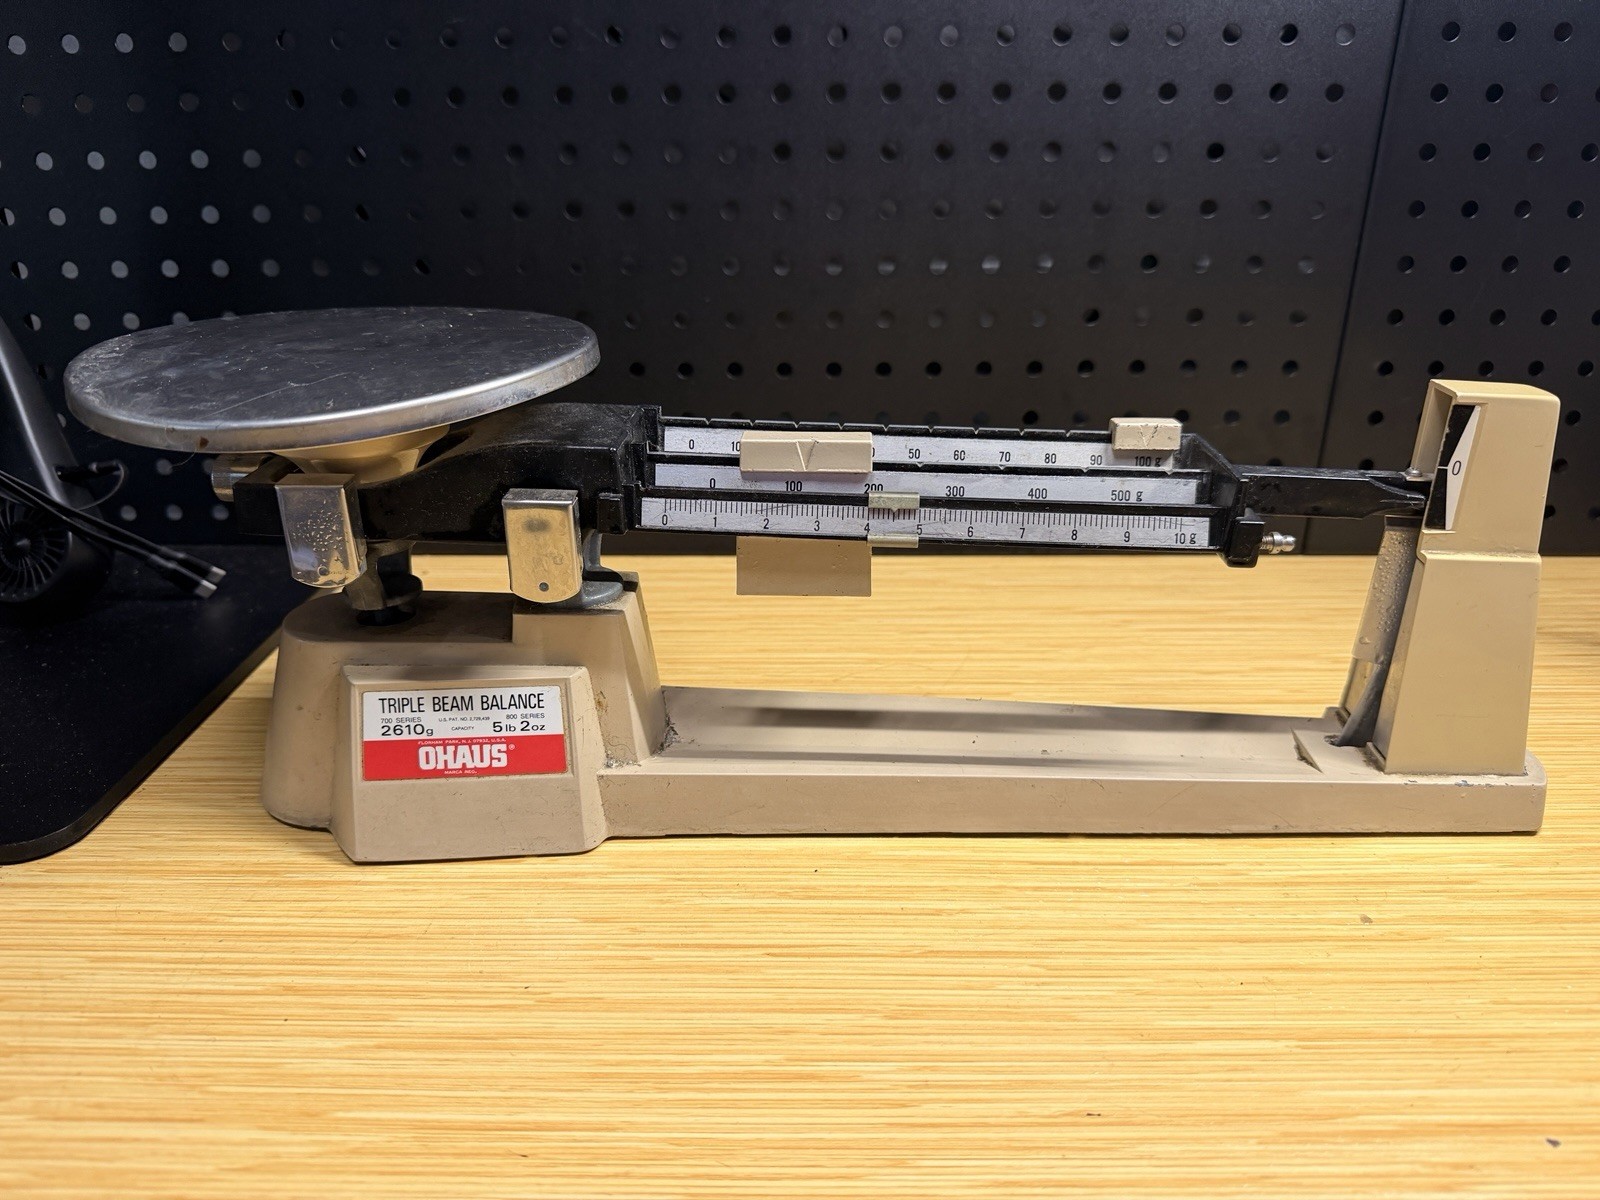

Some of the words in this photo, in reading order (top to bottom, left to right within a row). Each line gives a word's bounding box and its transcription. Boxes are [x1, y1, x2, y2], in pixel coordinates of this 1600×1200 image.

[688, 439, 695, 450] 0
[731, 441, 741, 452] 10
[908, 448, 921, 460] 50
[953, 450, 966, 461] 60
[999, 451, 1011, 463] 70
[1044, 453, 1057, 465] 80
[1089, 454, 1103, 466] 90
[1134, 456, 1152, 467] 100
[1451, 460, 1462, 476] 0
[709, 478, 716, 489] 0
[784, 481, 803, 492] 100
[863, 483, 884, 494] 200
[945, 486, 965, 497] 300
[1027, 488, 1048, 500] 400
[1110, 490, 1131, 502] 500
[1135, 491, 1144, 502] g
[661, 514, 668, 526] 0
[712, 516, 718, 528] 1
[763, 518, 770, 530] 2
[813, 520, 821, 532] 3
[863, 522, 871, 534] 4
[916, 524, 923, 536] 5
[967, 526, 974, 538] 6
[1019, 528, 1026, 539] 7
[1071, 529, 1078, 541] 8
[1123, 531, 1131, 543] 9
[1174, 532, 1186, 545] 10
[1189, 533, 1197, 545] g
[378, 696, 426, 714] TRIPLE
[432, 695, 475, 713] BEAM
[480, 692, 546, 711] BALANCE
[380, 717, 394, 725] 700
[395, 716, 422, 724] SERIES
[520, 712, 546, 720] SERIES
[380, 723, 434, 737] 2610g
[418, 744, 508, 770] OHAUS
